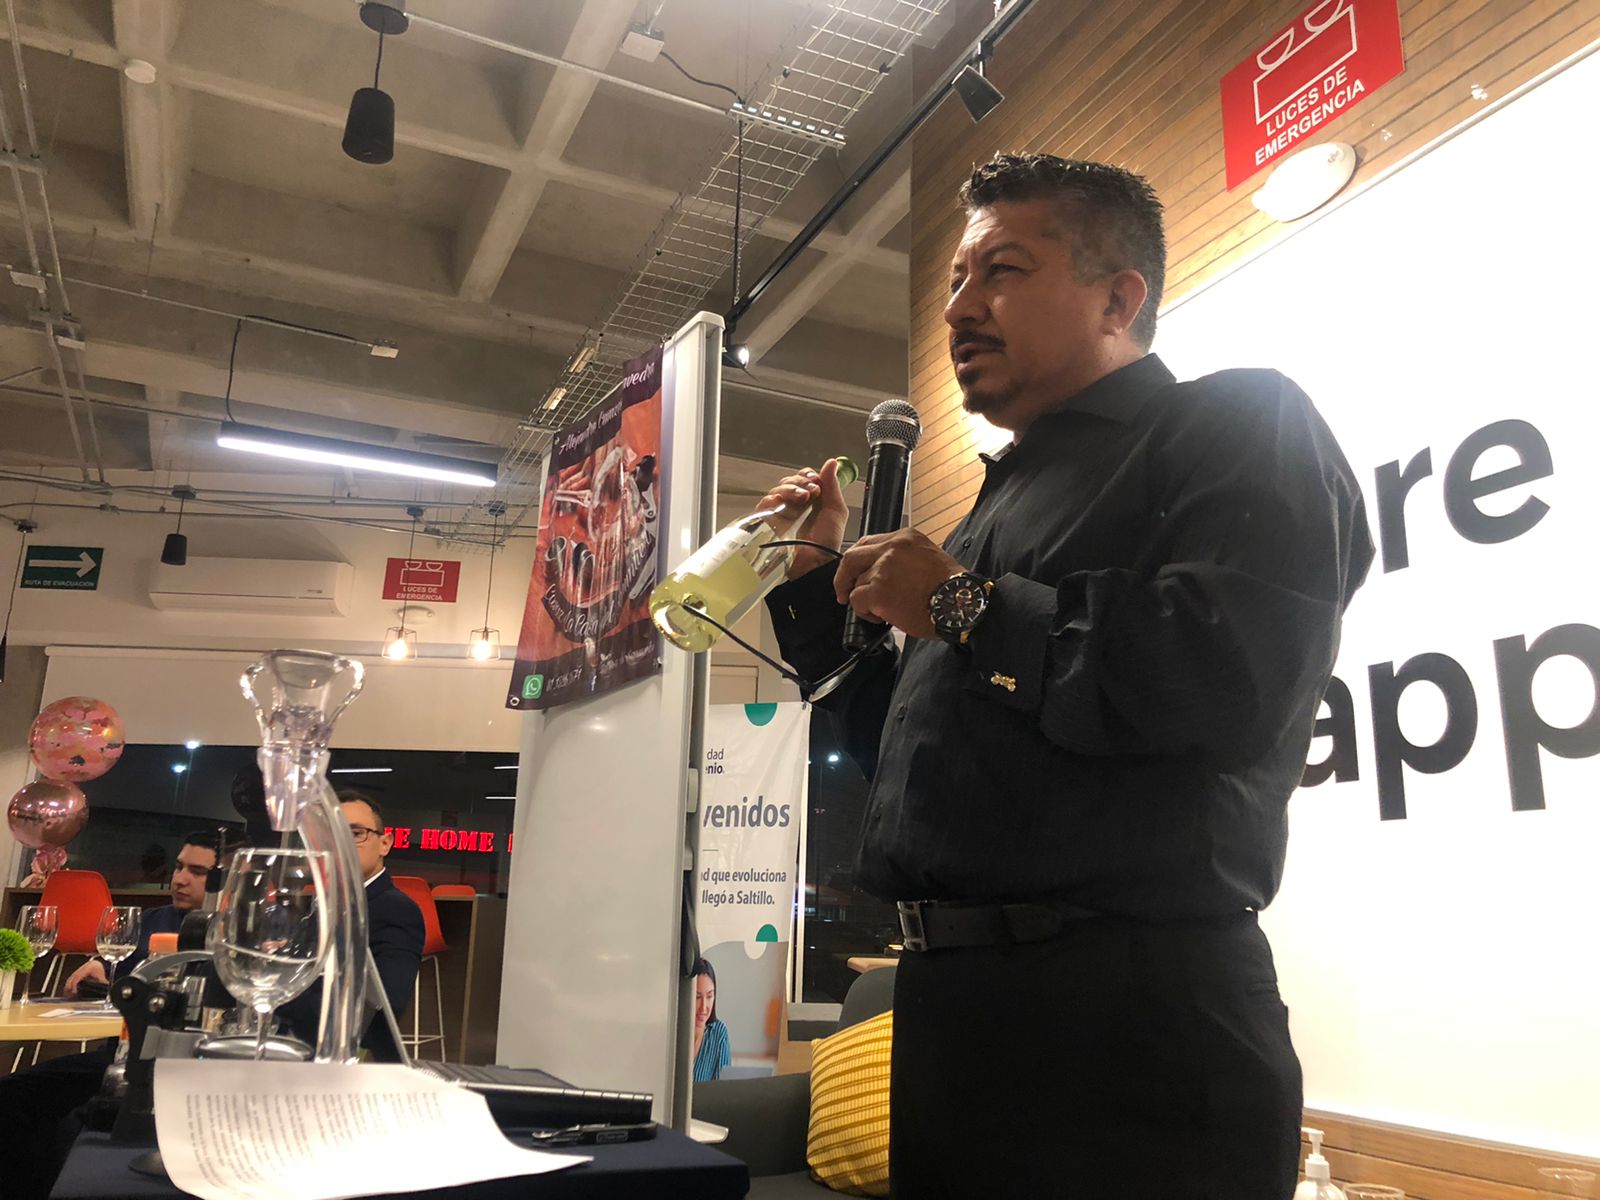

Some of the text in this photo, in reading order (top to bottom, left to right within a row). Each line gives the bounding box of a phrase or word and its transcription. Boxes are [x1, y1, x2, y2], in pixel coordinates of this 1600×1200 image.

[1266, 65, 1347, 137] LUCES DE
[1255, 79, 1365, 166] EMERGENCIA
[1373, 418, 1554, 574] re
[706, 748, 725, 761] dad
[420, 828, 495, 853] HOME
[701, 867, 787, 885] d que evoluciona
[701, 889, 775, 908] llegó a Saltillo.
